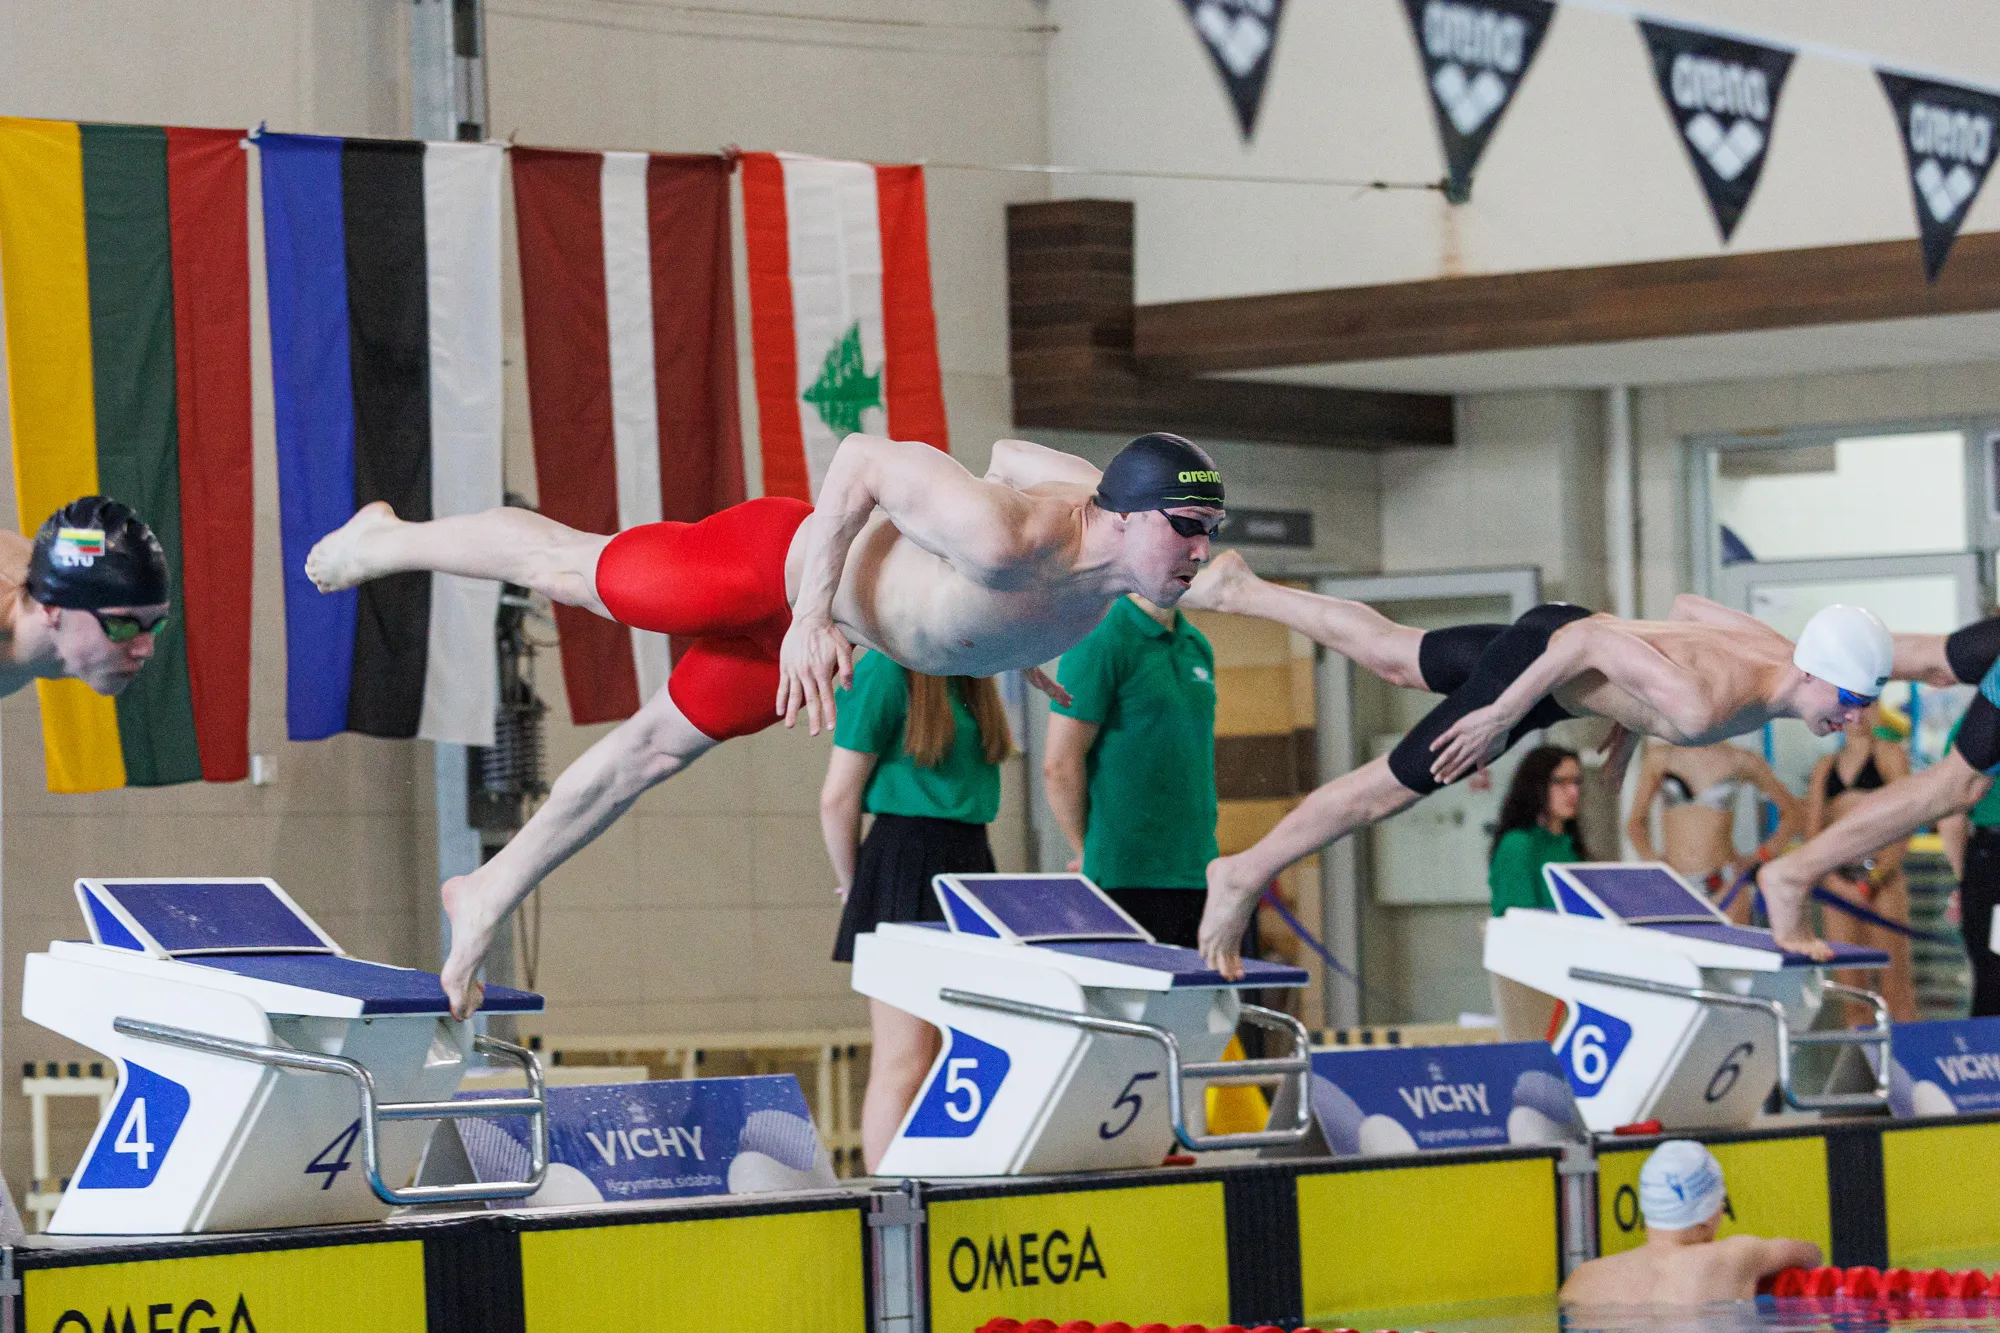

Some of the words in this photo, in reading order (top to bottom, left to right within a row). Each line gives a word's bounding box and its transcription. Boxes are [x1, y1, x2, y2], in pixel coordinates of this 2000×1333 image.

[1672, 54, 1769, 119] arena
[1910, 103, 1990, 166] arena
[1178, 471, 1221, 483] arena
[1571, 1024, 1609, 1085] 6
[1705, 1041, 1754, 1103] 6
[944, 1058, 982, 1122] 5
[1100, 1072, 1161, 1140] 5
[1398, 1081, 1491, 1119] VICHY
[114, 1097, 154, 1169] 4
[304, 1118, 362, 1190] 4
[585, 1125, 705, 1167] VICHY
[949, 1226, 1107, 1293] OMEGA
